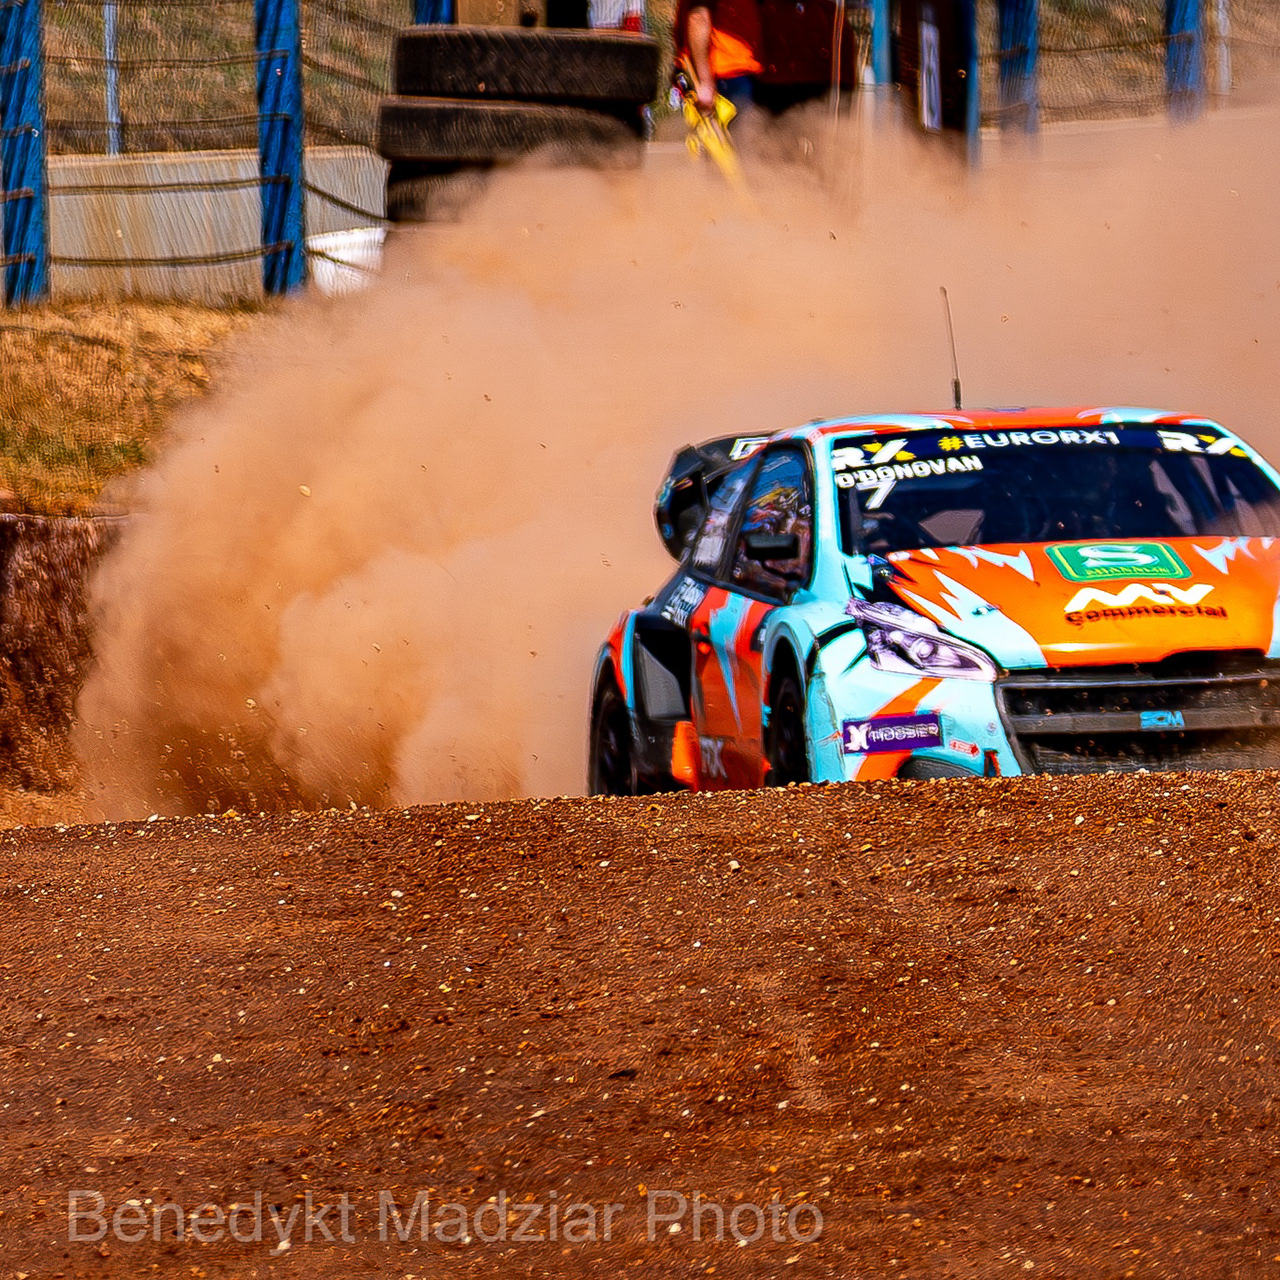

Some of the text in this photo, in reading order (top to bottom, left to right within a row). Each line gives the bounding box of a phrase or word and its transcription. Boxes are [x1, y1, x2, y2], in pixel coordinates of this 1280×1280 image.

[937, 430, 1120, 453] #EURORX1
[834, 455, 984, 488] O'DONOVAN
[1064, 605, 1229, 627] Commercial
